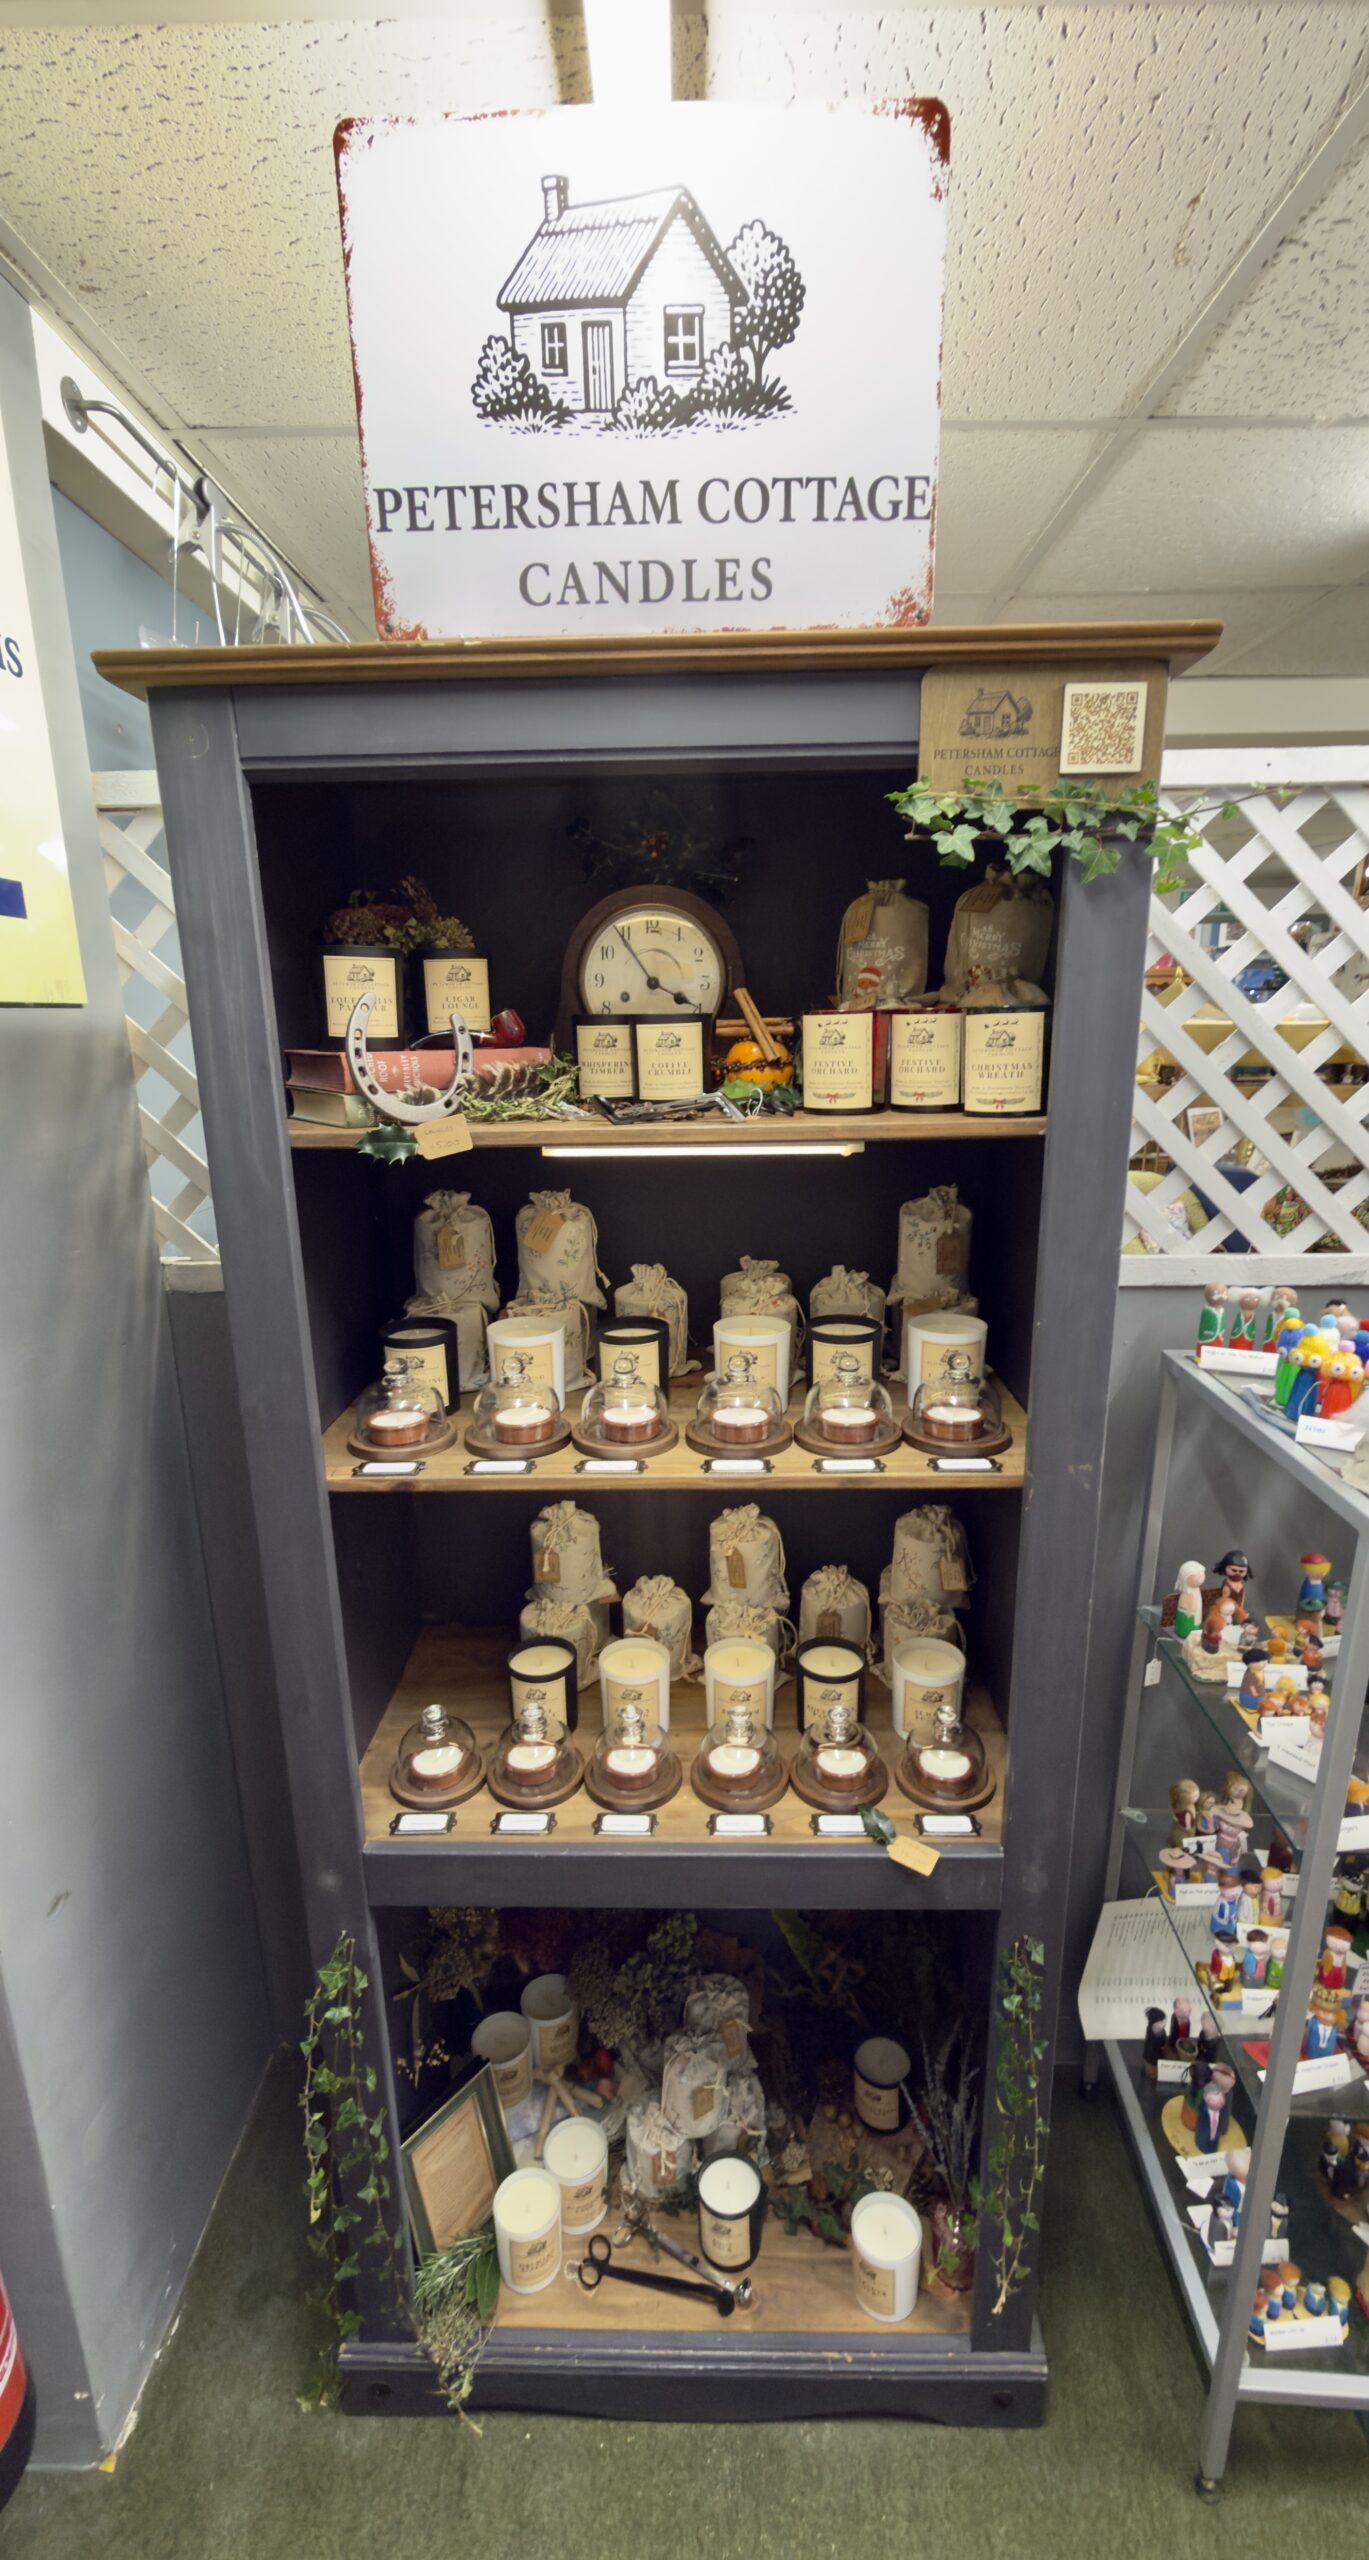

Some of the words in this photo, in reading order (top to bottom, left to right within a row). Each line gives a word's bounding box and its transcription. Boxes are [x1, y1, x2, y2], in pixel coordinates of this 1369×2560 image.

[373, 478, 683, 534] PETERSHAM
[696, 475, 932, 524] COTTAGE
[519, 556, 775, 607] CANDLES
[933, 747, 1004, 760] PETERSHAM
[964, 764, 1025, 776] CANDLES
[645, 919, 660, 934] 12
[620, 926, 631, 940] 11
[601, 945, 615, 960] 10
[694, 947, 703, 962] 2
[594, 972, 605, 988] 9
[699, 975, 710, 990] 3
[441, 1002, 480, 1010] LOUNGE
[601, 1000, 611, 1014] 8
[651, 1061, 688, 1069] COFFEE
[812, 1060, 853, 1068] FESTIVE
[901, 1059, 941, 1067] FESTIVE
[971, 1063, 1033, 1072] CHRISTMAS
[590, 1067, 625, 1075] TIMBER
[811, 1067, 858, 1076] ORCHARD
[898, 1066, 946, 1074] ORCHARD
[978, 1071, 1025, 1080] WREATH
